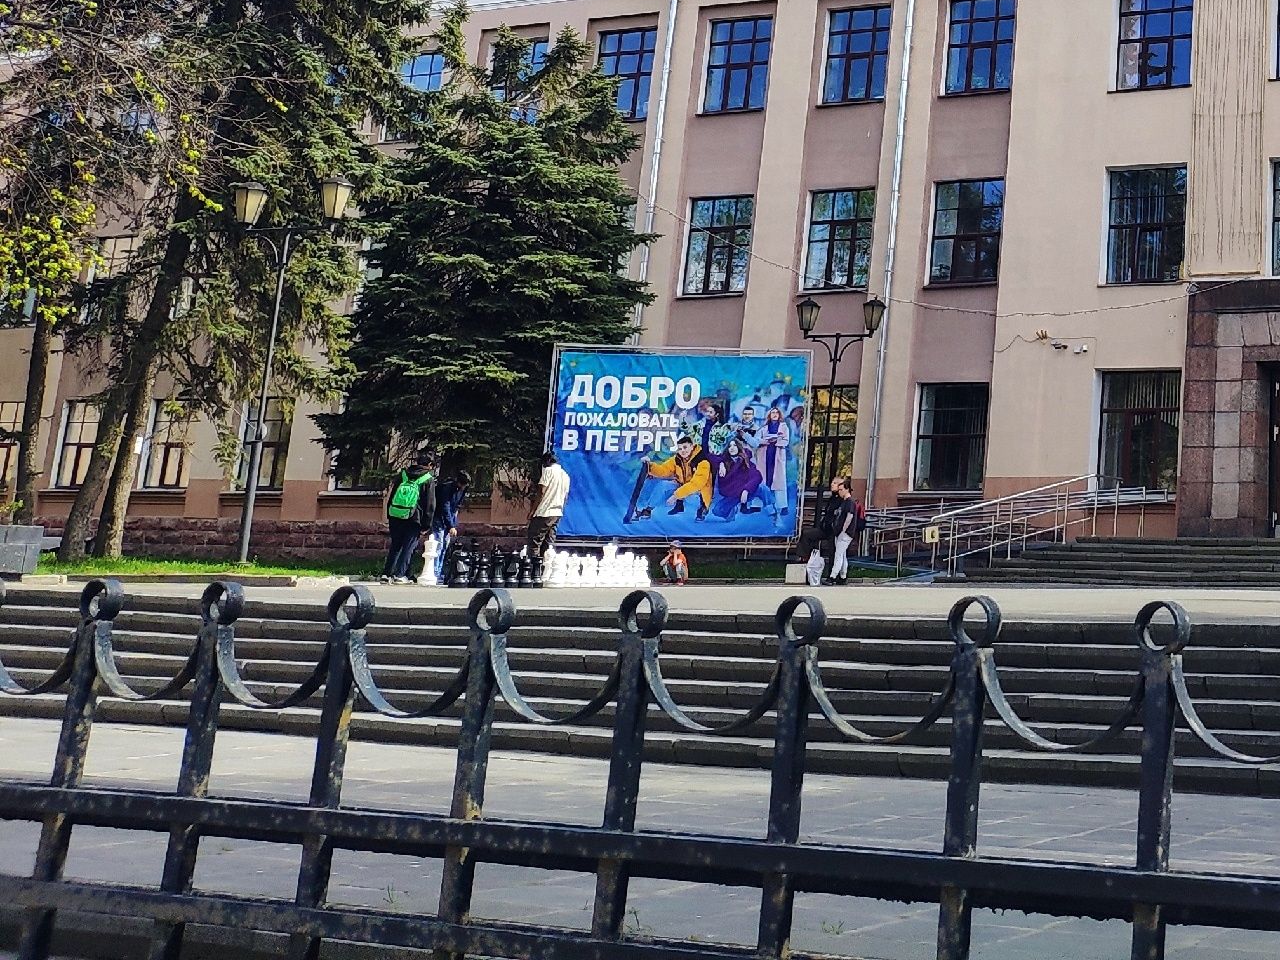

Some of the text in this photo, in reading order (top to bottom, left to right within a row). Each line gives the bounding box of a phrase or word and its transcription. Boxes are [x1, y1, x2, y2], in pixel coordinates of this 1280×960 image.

[565, 374, 701, 410] ДОБРО
[564, 411, 680, 428] ПОЖАЛОВАТЬ
[561, 429, 685, 452] В ПЕТРГУ
